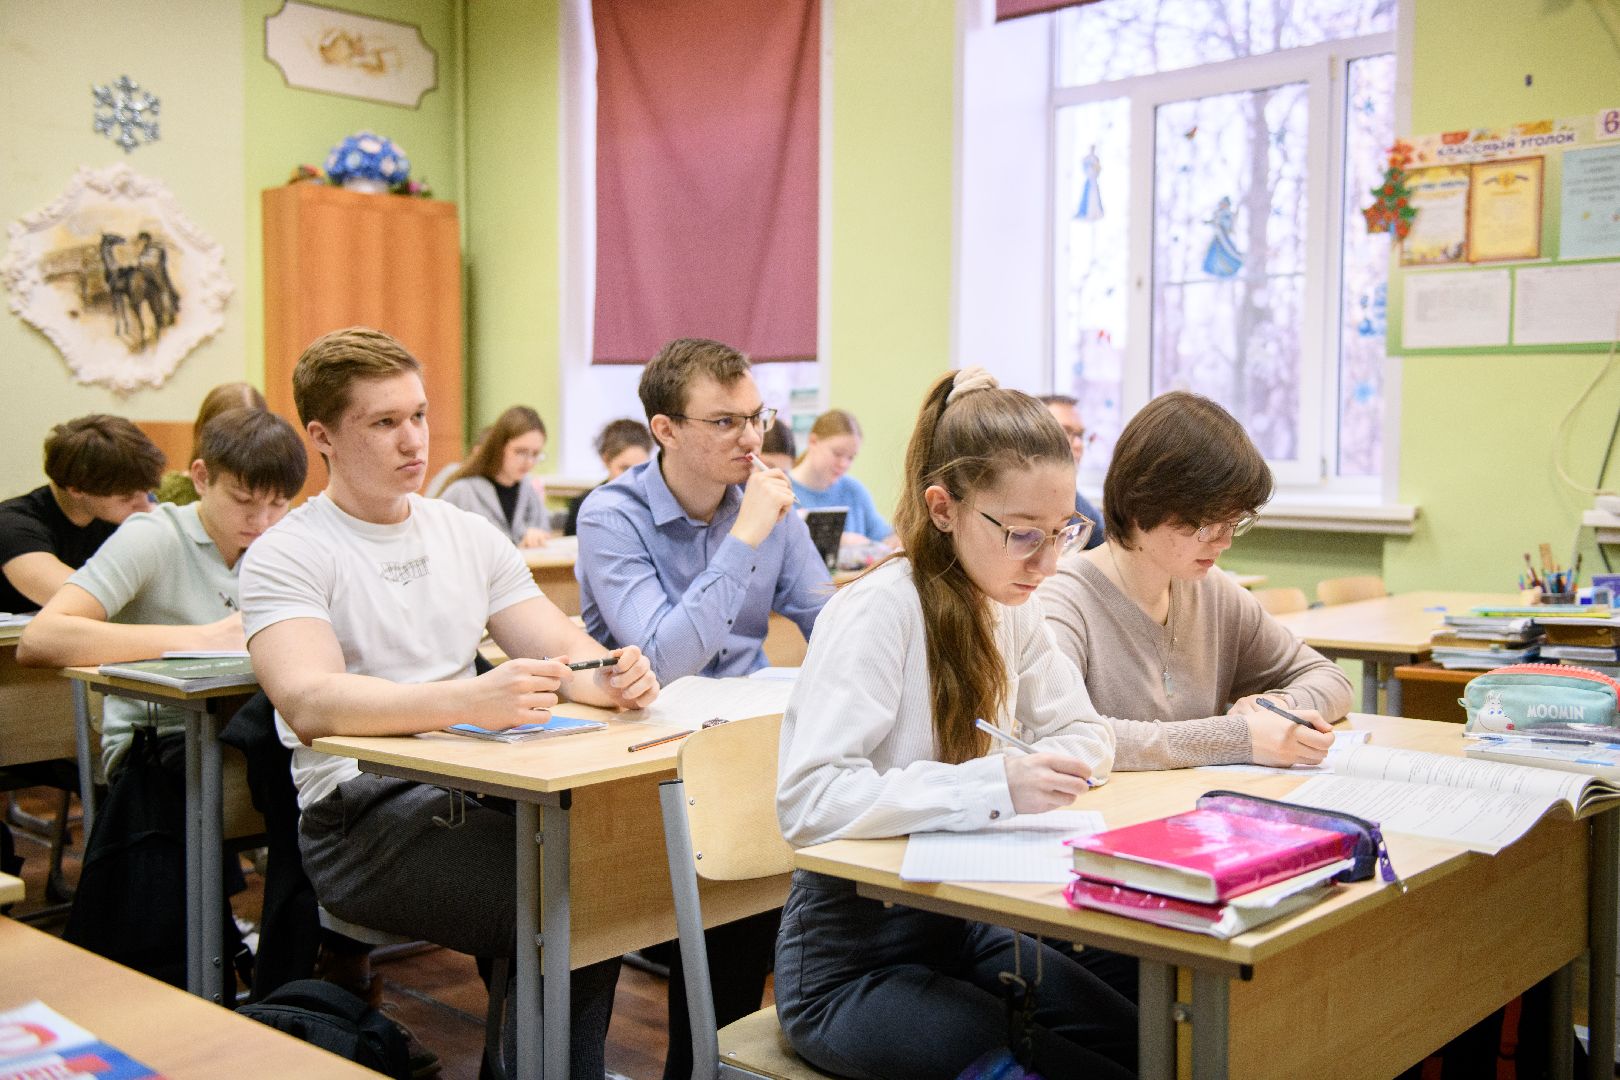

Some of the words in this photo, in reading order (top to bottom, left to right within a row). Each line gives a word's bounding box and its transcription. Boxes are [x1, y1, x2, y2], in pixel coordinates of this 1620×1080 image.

[1604, 111, 1620, 134] 6
[1437, 139, 1516, 157] КЛАССНЫЙ
[1520, 133, 1575, 148] УГОЛОК
[1527, 704, 1584, 720] MOOMIN
